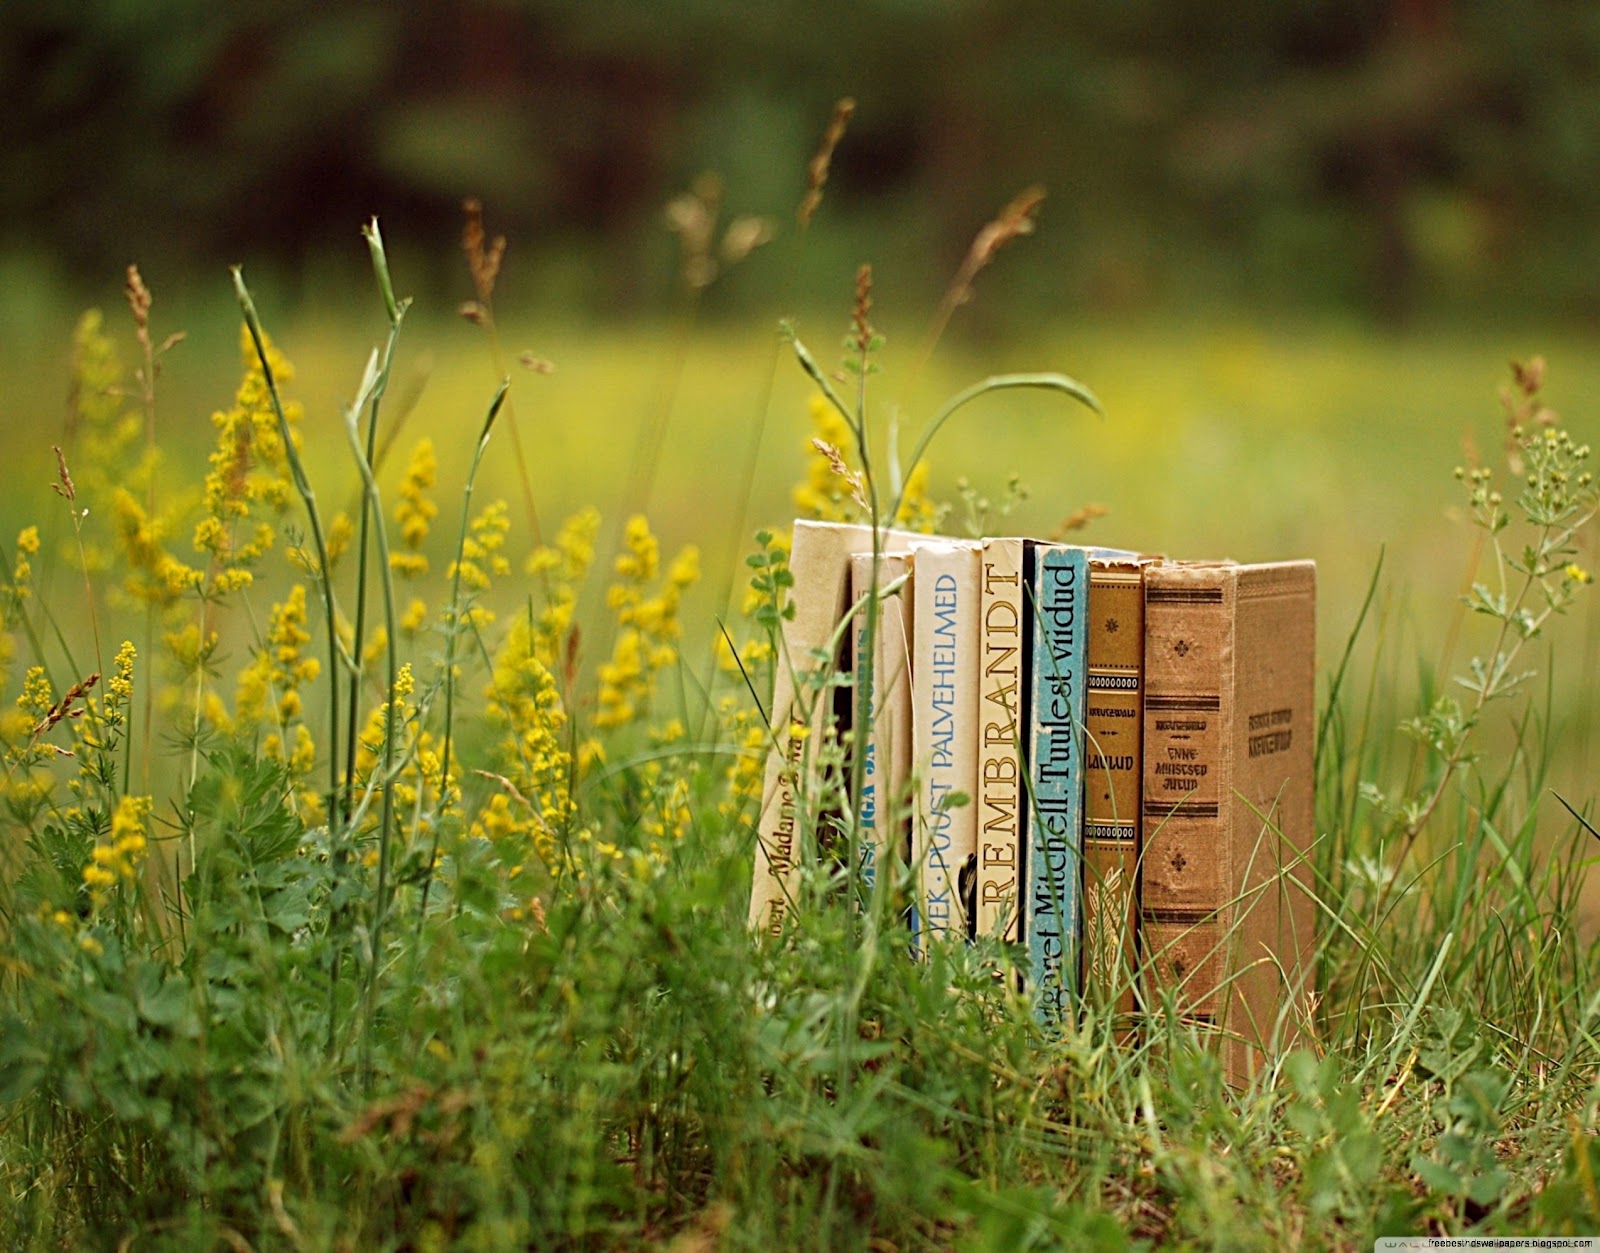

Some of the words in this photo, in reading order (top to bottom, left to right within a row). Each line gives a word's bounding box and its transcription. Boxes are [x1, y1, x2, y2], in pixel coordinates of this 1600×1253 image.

[1042, 565, 1075, 661] viidud
[931, 574, 957, 768] PALVEHELMED
[982, 563, 1019, 906] REMBRANDT
[1039, 669, 1073, 783] Tuulest
[1088, 754, 1133, 770] LAULUD
[929, 778, 953, 868] PUUST
